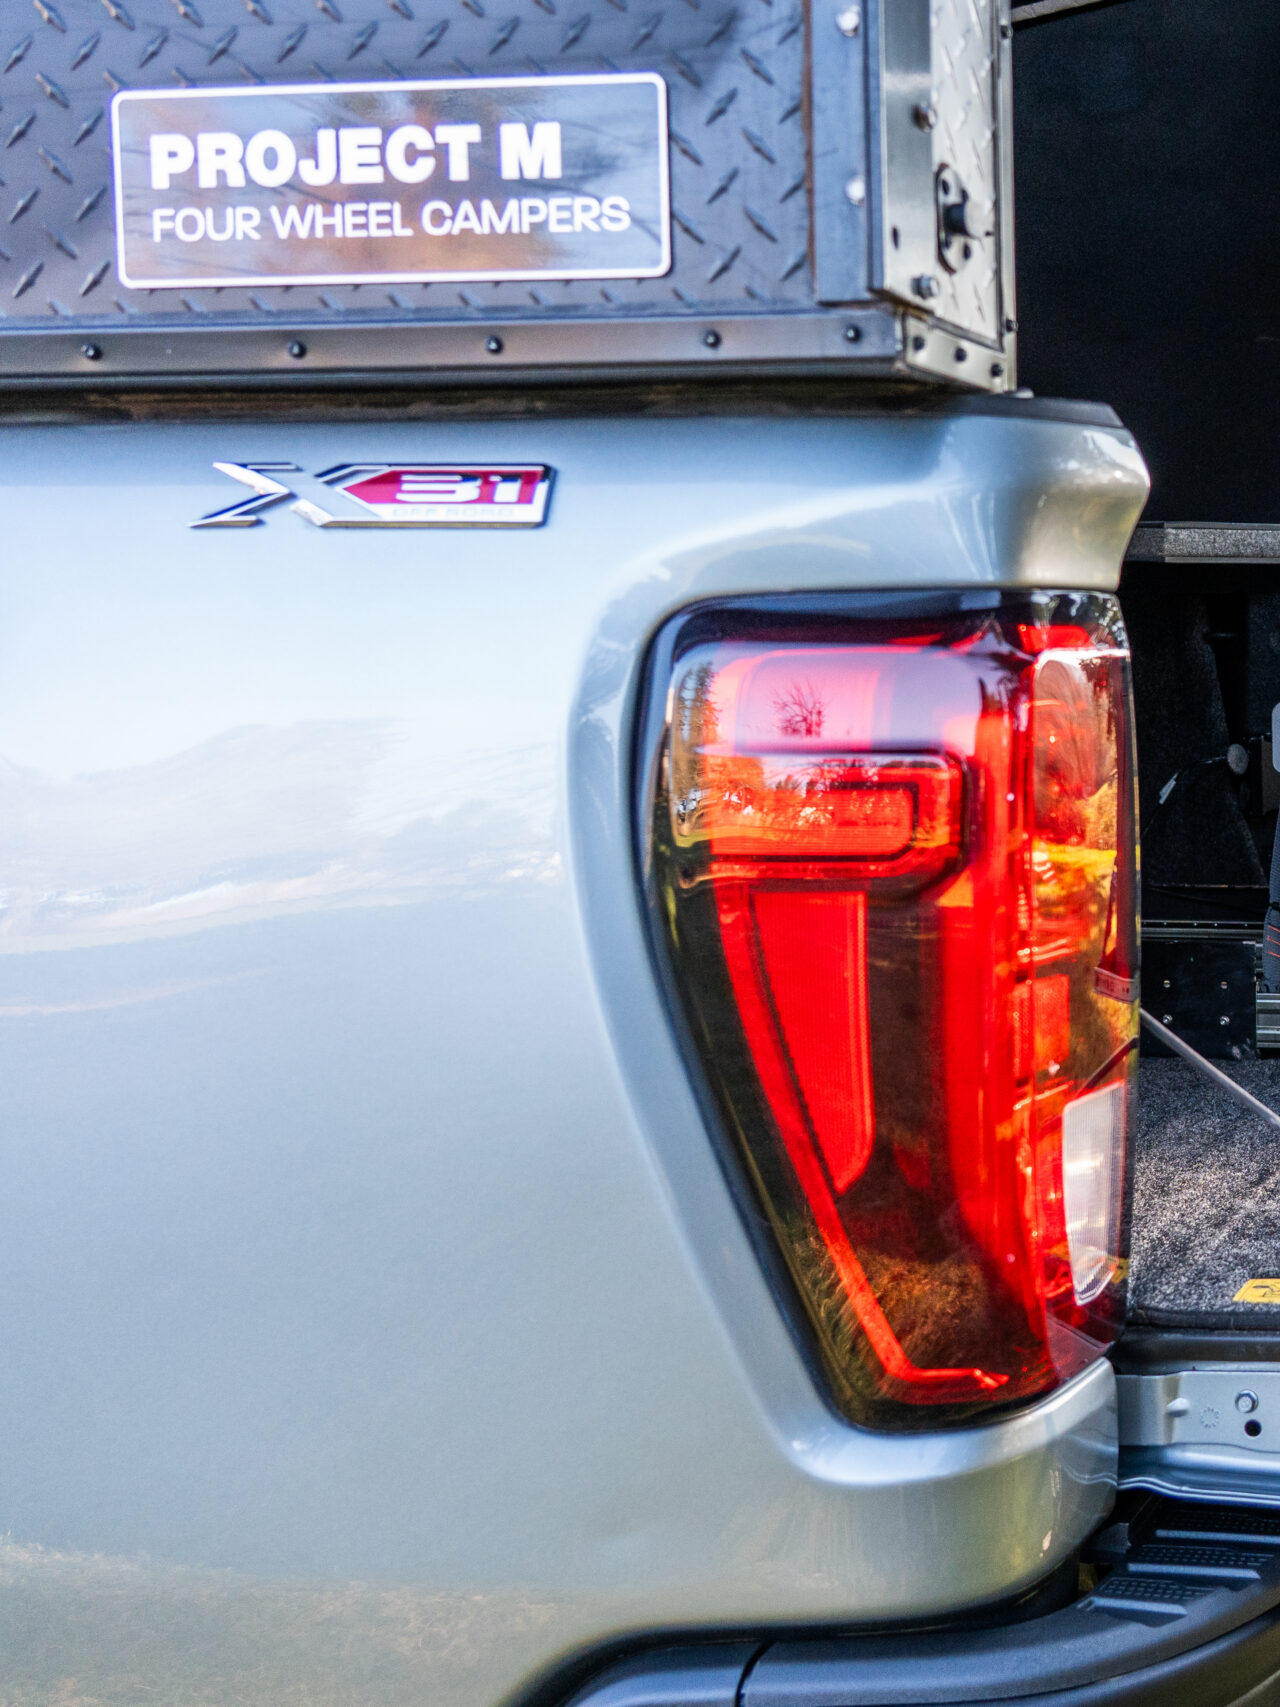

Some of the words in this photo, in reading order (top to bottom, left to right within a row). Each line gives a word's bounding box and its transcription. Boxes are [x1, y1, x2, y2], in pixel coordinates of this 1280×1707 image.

[150, 122, 480, 190] PROJECT
[501, 122, 562, 180] M
[153, 206, 261, 243] FOUR
[272, 201, 413, 240] WHEEL
[422, 195, 631, 237] CAMPERS
[393, 508, 439, 517] OFF
[445, 508, 515, 517] ROAD
